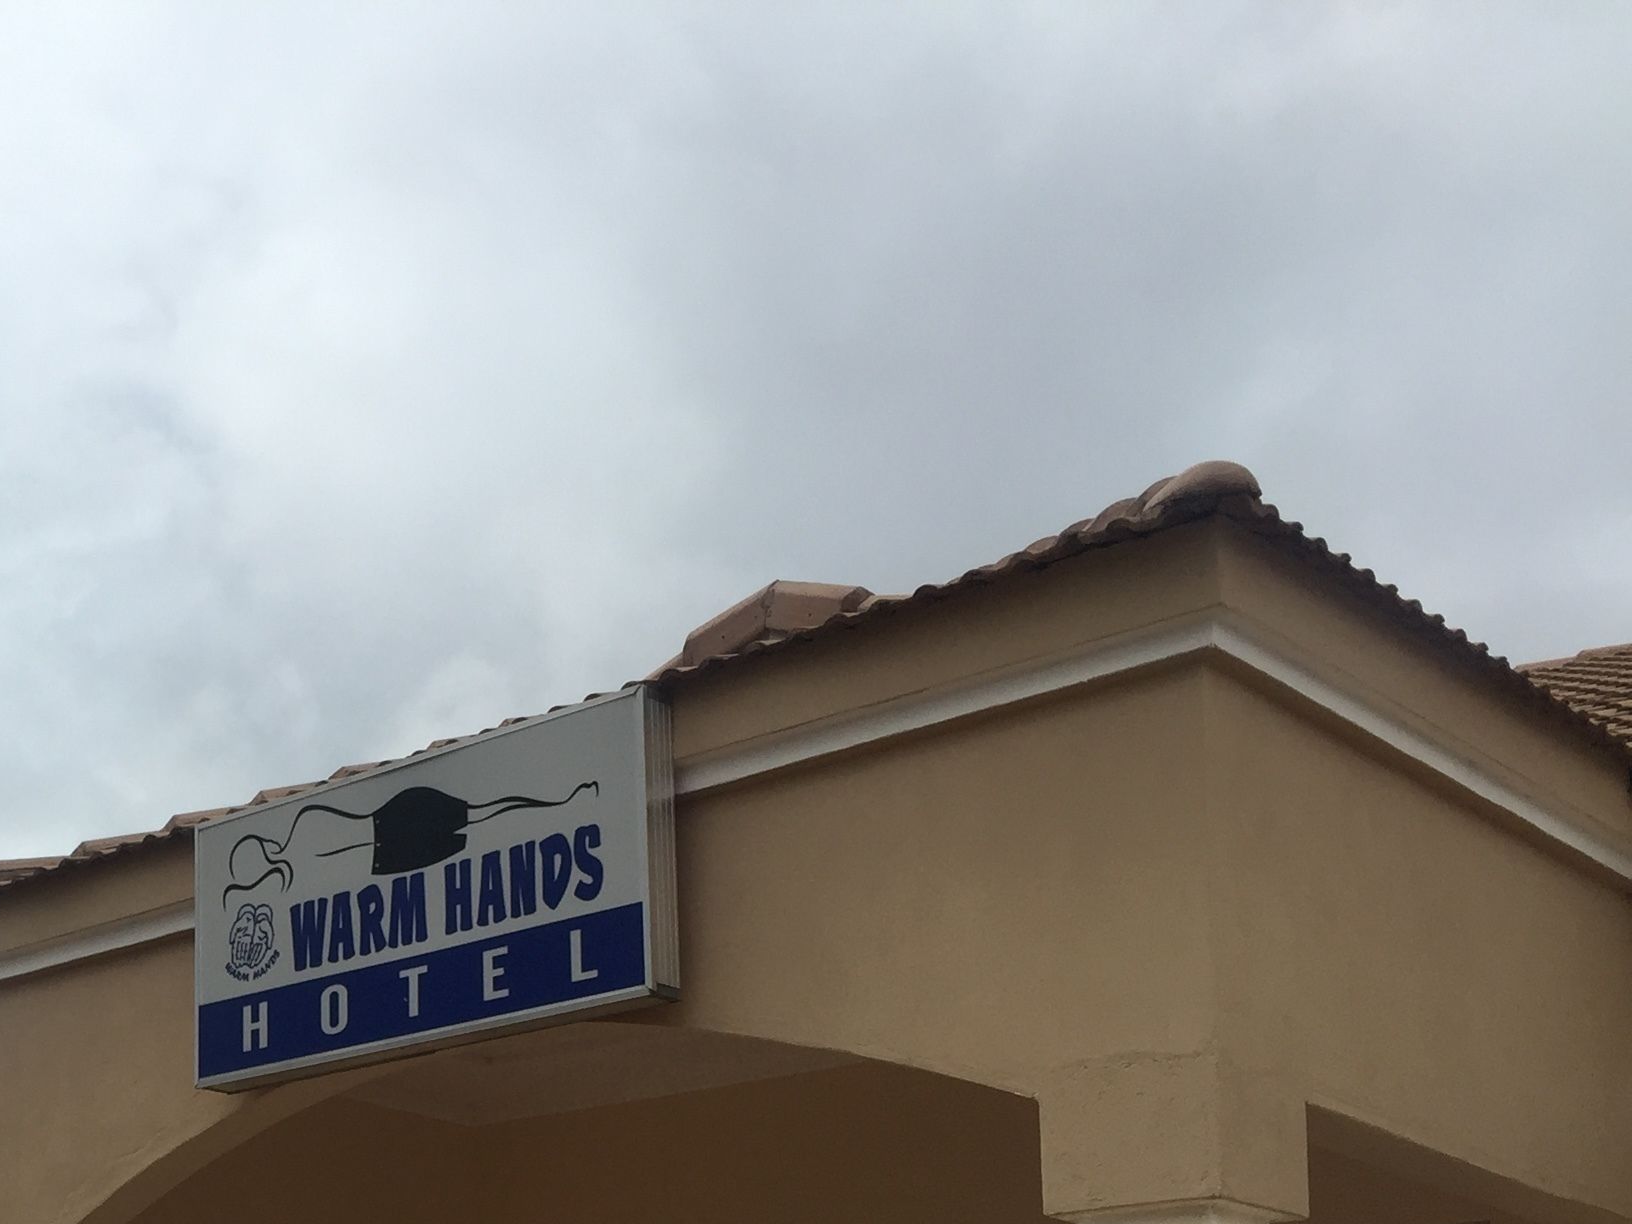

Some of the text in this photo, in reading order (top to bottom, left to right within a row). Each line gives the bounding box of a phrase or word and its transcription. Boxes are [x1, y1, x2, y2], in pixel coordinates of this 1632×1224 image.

[290, 824, 604, 972] WARM HANDS
[225, 949, 280, 982] WARM HANDS
[242, 929, 598, 1052] HOTEL
